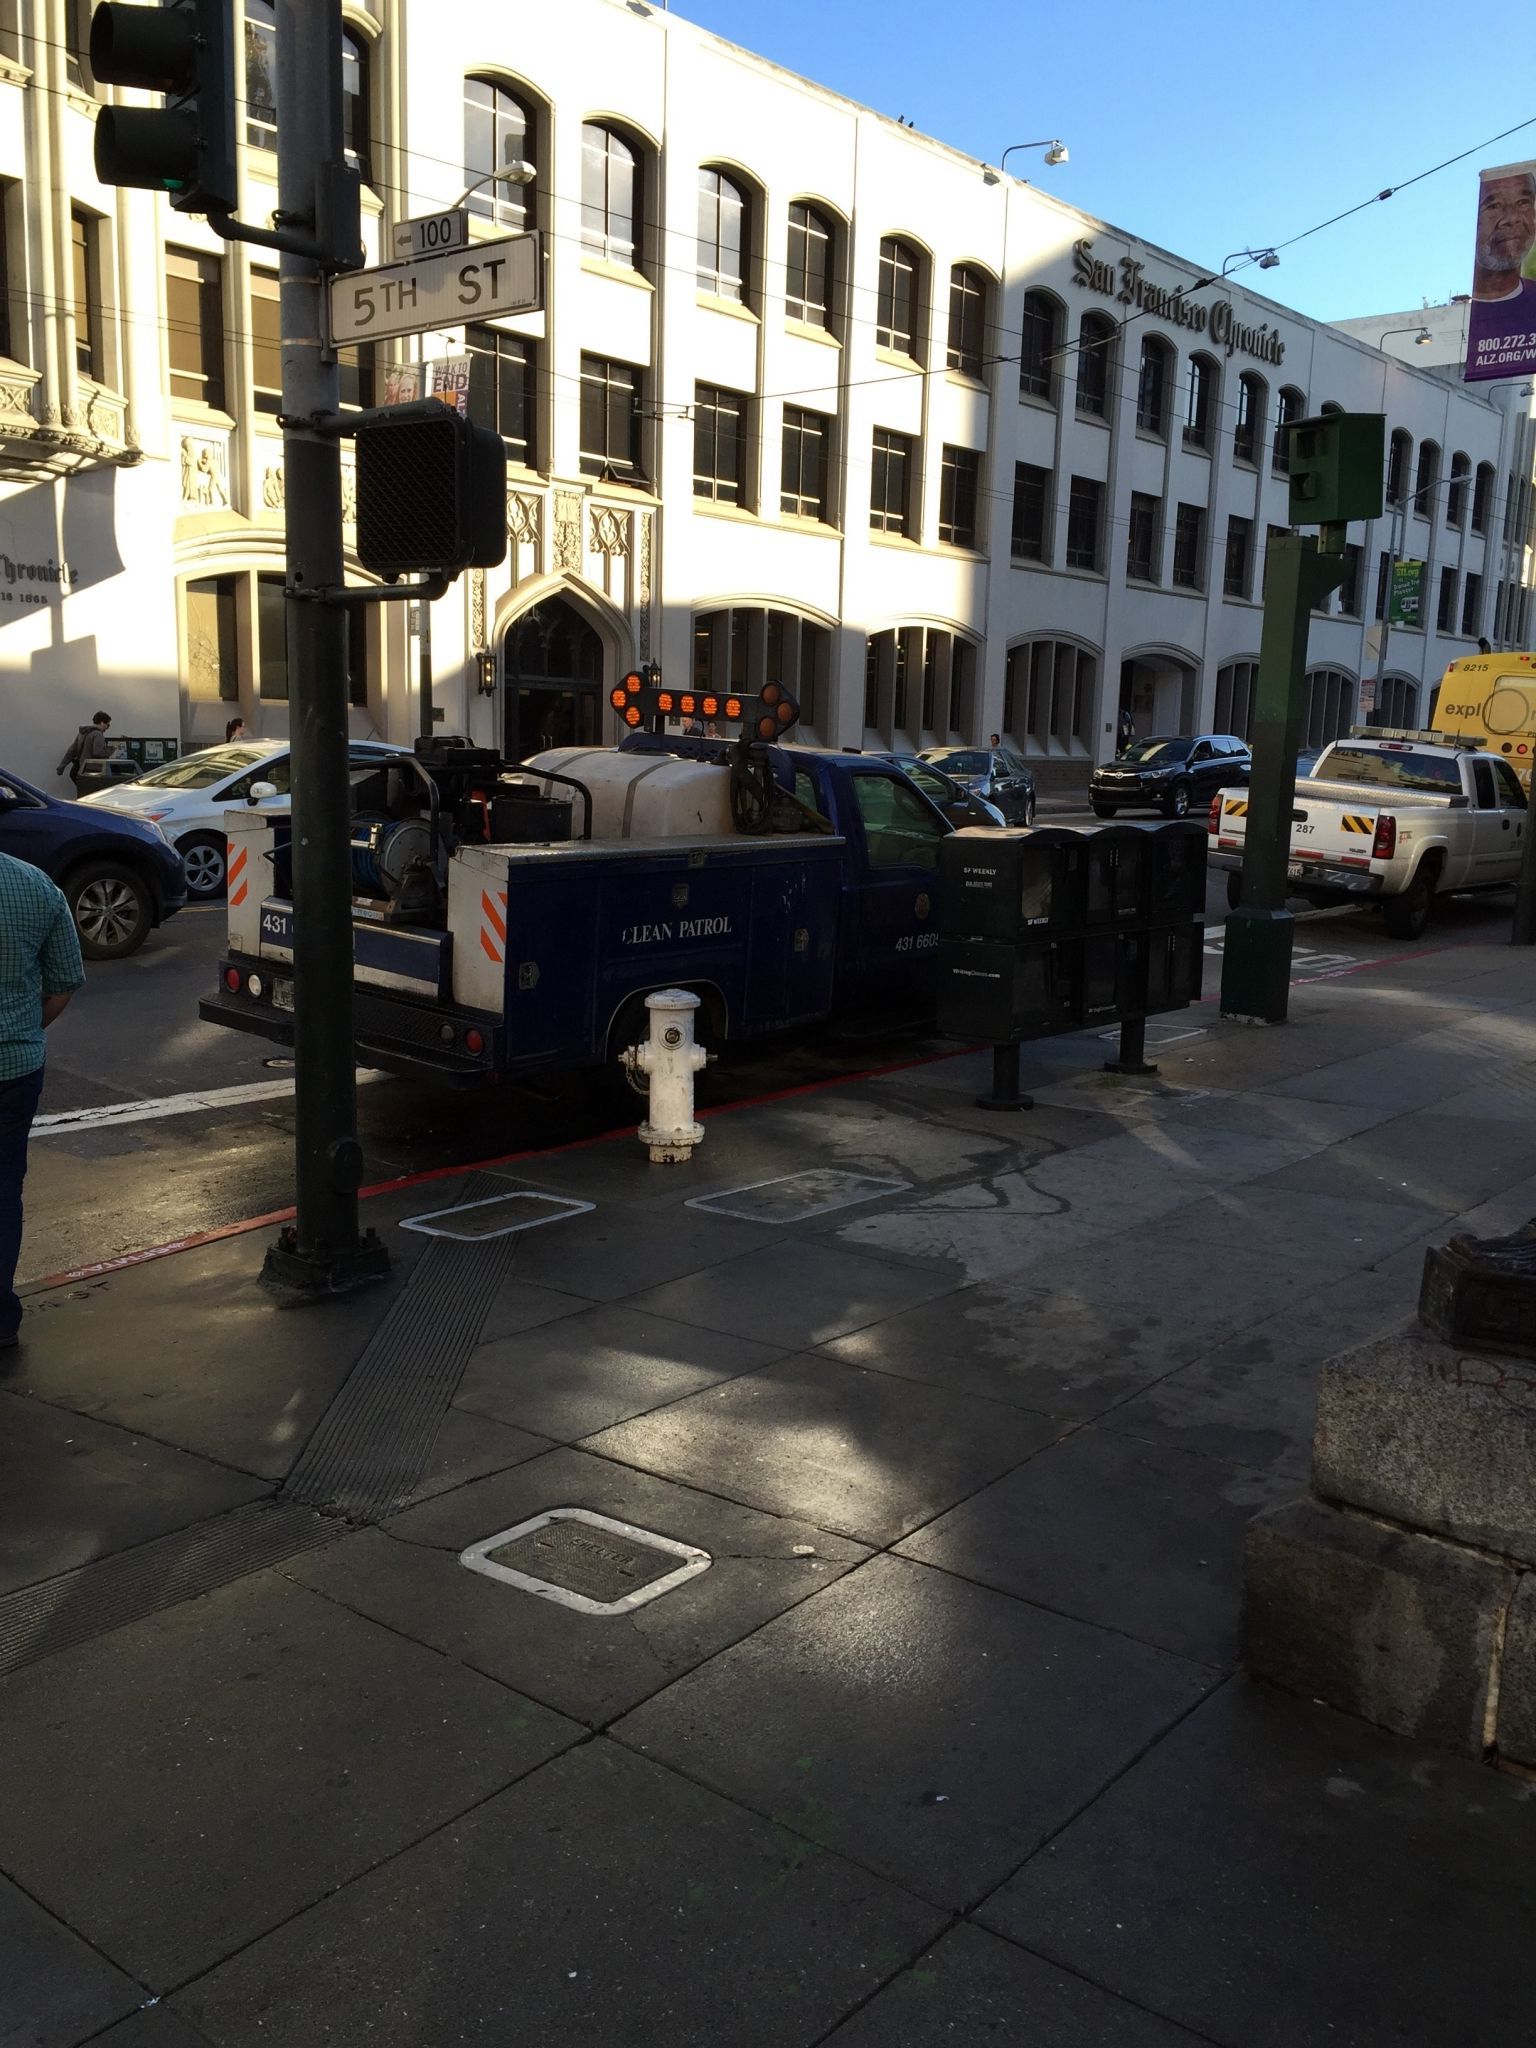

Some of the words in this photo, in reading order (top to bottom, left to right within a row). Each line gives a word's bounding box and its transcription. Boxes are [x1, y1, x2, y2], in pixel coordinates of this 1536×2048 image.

[420, 217, 451, 249] 100
[354, 277, 417, 326] 5TH
[458, 258, 506, 305] ST
[1072, 238, 1117, 296] San
[1117, 255, 1208, 333] Francisco
[1209, 299, 1286, 366] Chronicle
[458, 361, 468, 374] TO
[433, 373, 468, 393] END
[20, 594, 48, 604] 1865
[1463, 663, 1489, 672] 8215
[1296, 824, 1315, 834] 287
[973, 867, 997, 875] WEEKLY
[263, 914, 287, 935] 431
[622, 922, 673, 944] CLEAN
[679, 917, 732, 938] PATROL
[895, 936, 914, 952] 431
